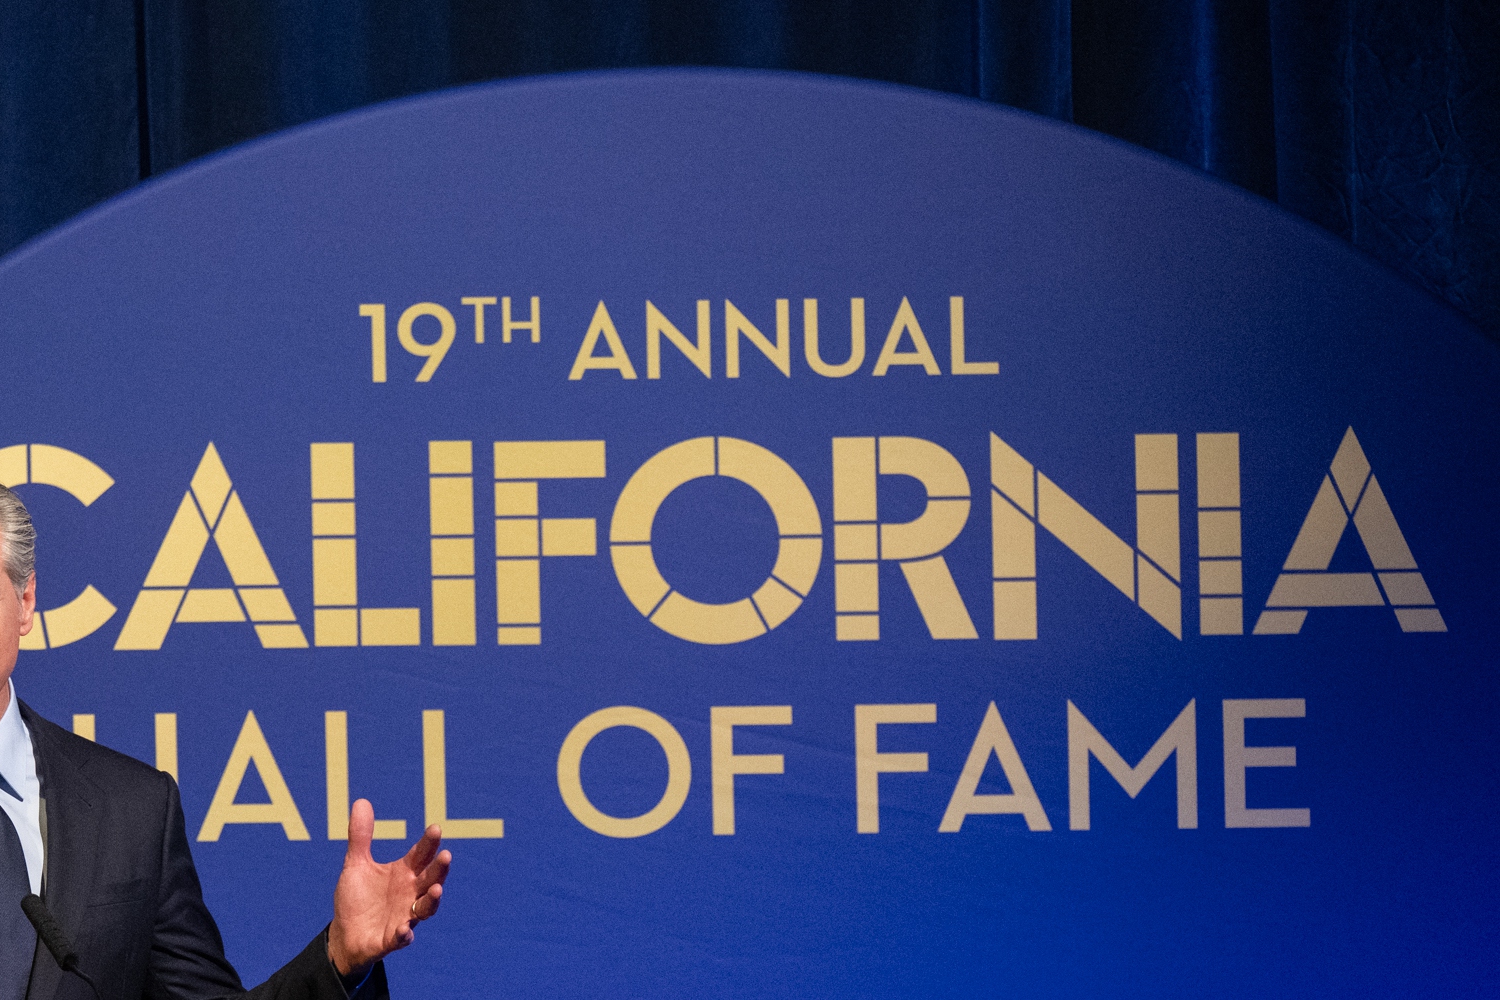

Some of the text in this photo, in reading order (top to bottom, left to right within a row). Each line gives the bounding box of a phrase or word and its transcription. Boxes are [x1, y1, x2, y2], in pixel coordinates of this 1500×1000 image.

[358, 295, 1000, 383] 19TH ANNUAL
[557, 705, 793, 839] OF
[854, 698, 1311, 834] FAME
